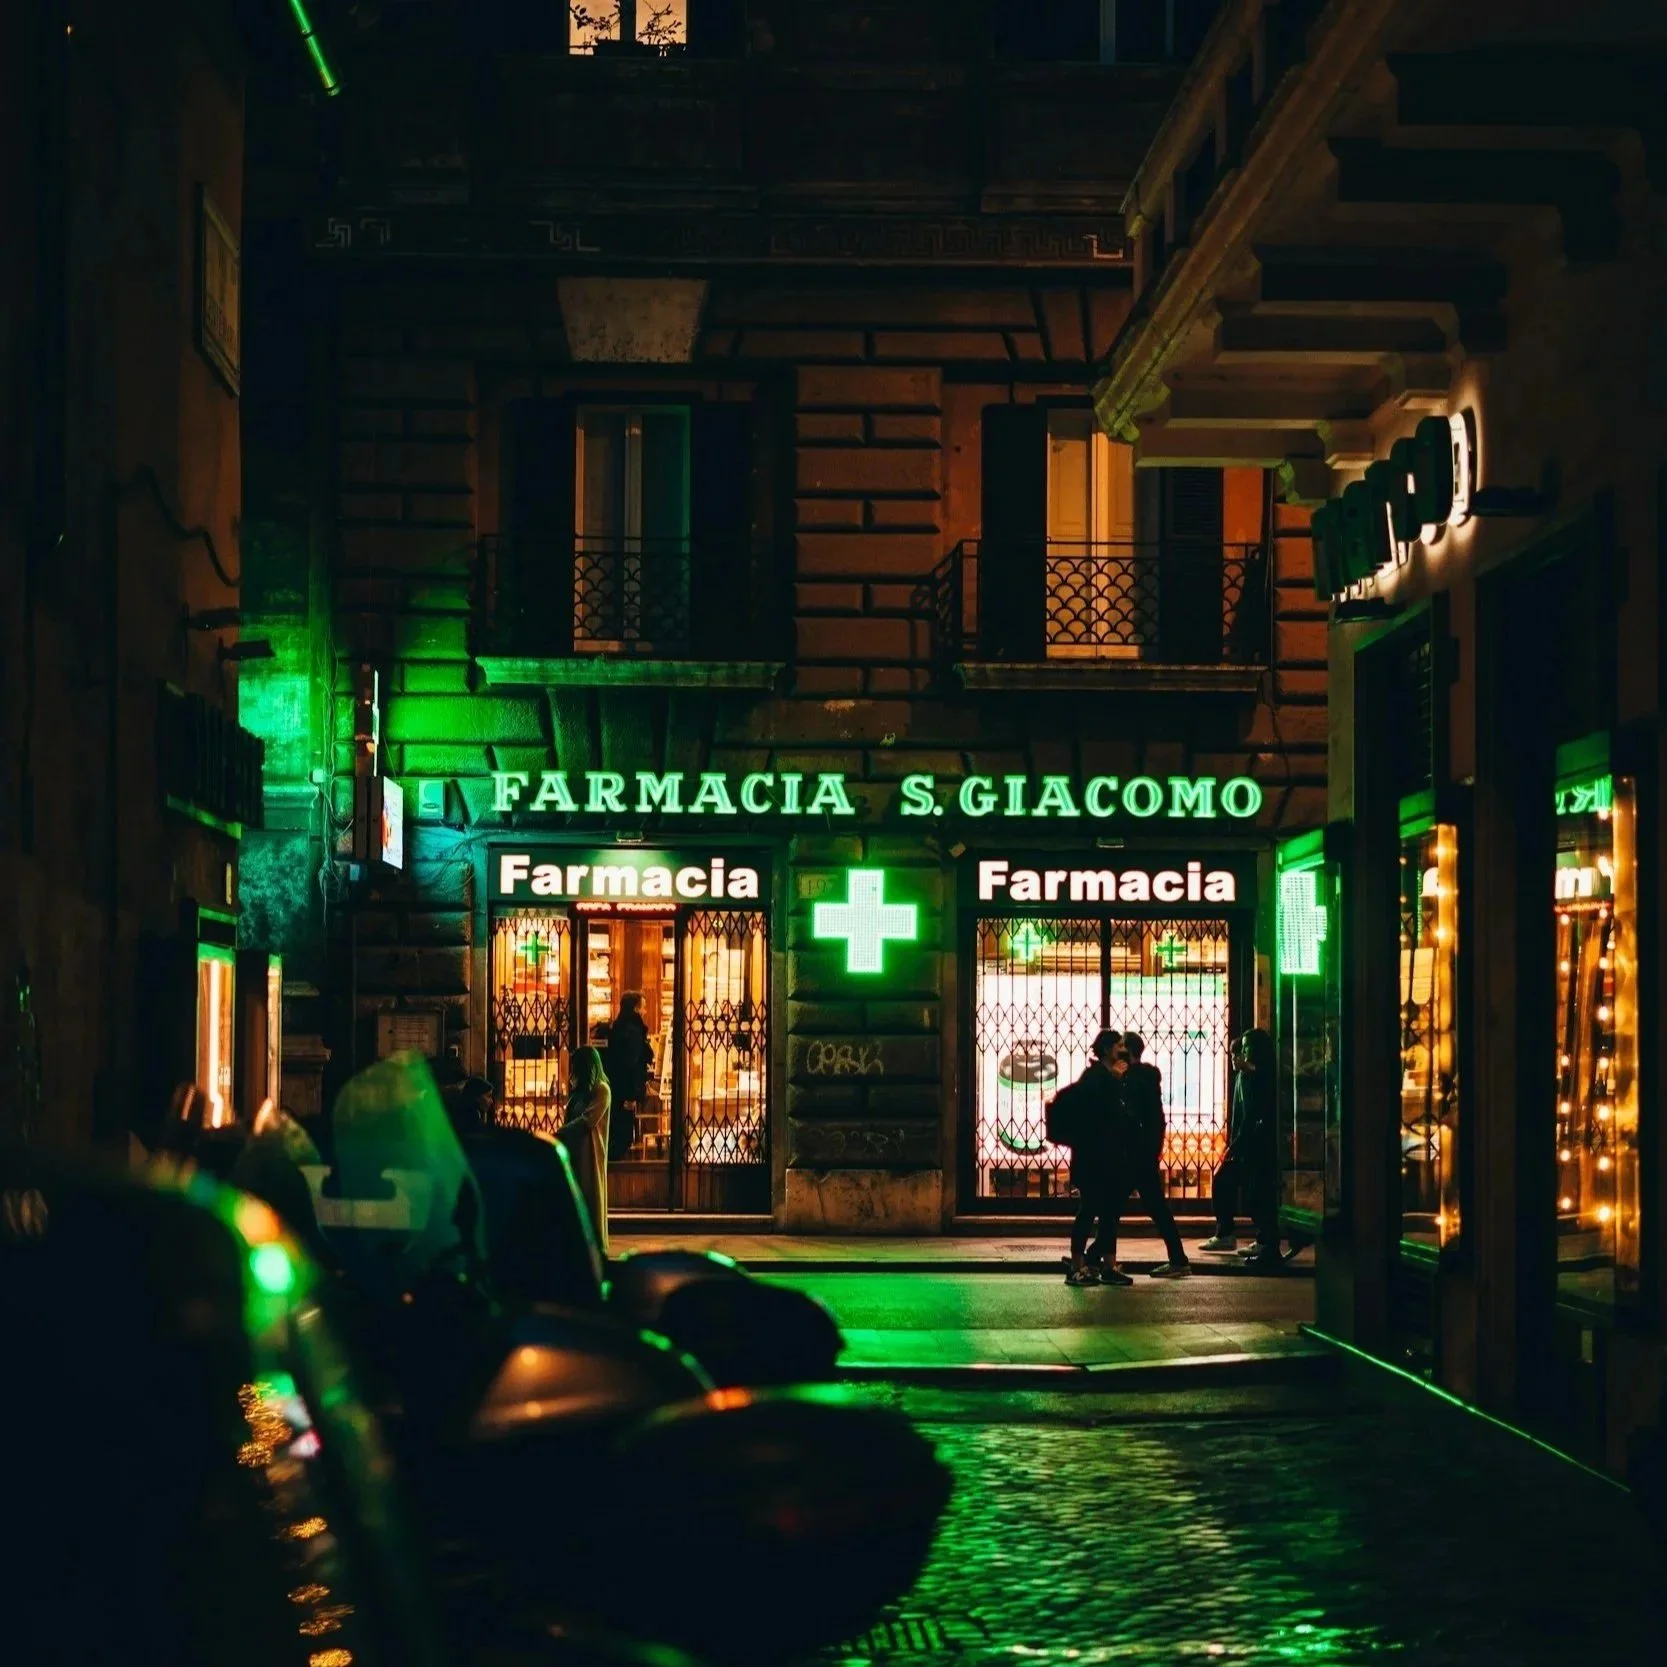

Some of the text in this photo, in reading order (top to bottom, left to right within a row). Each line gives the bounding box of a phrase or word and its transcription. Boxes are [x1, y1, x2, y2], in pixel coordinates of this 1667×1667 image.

[490, 770, 1263, 818] FARMACIA S. GIACOMO
[500, 853, 760, 899] Farmacia
[977, 859, 1237, 902] Farmacia
